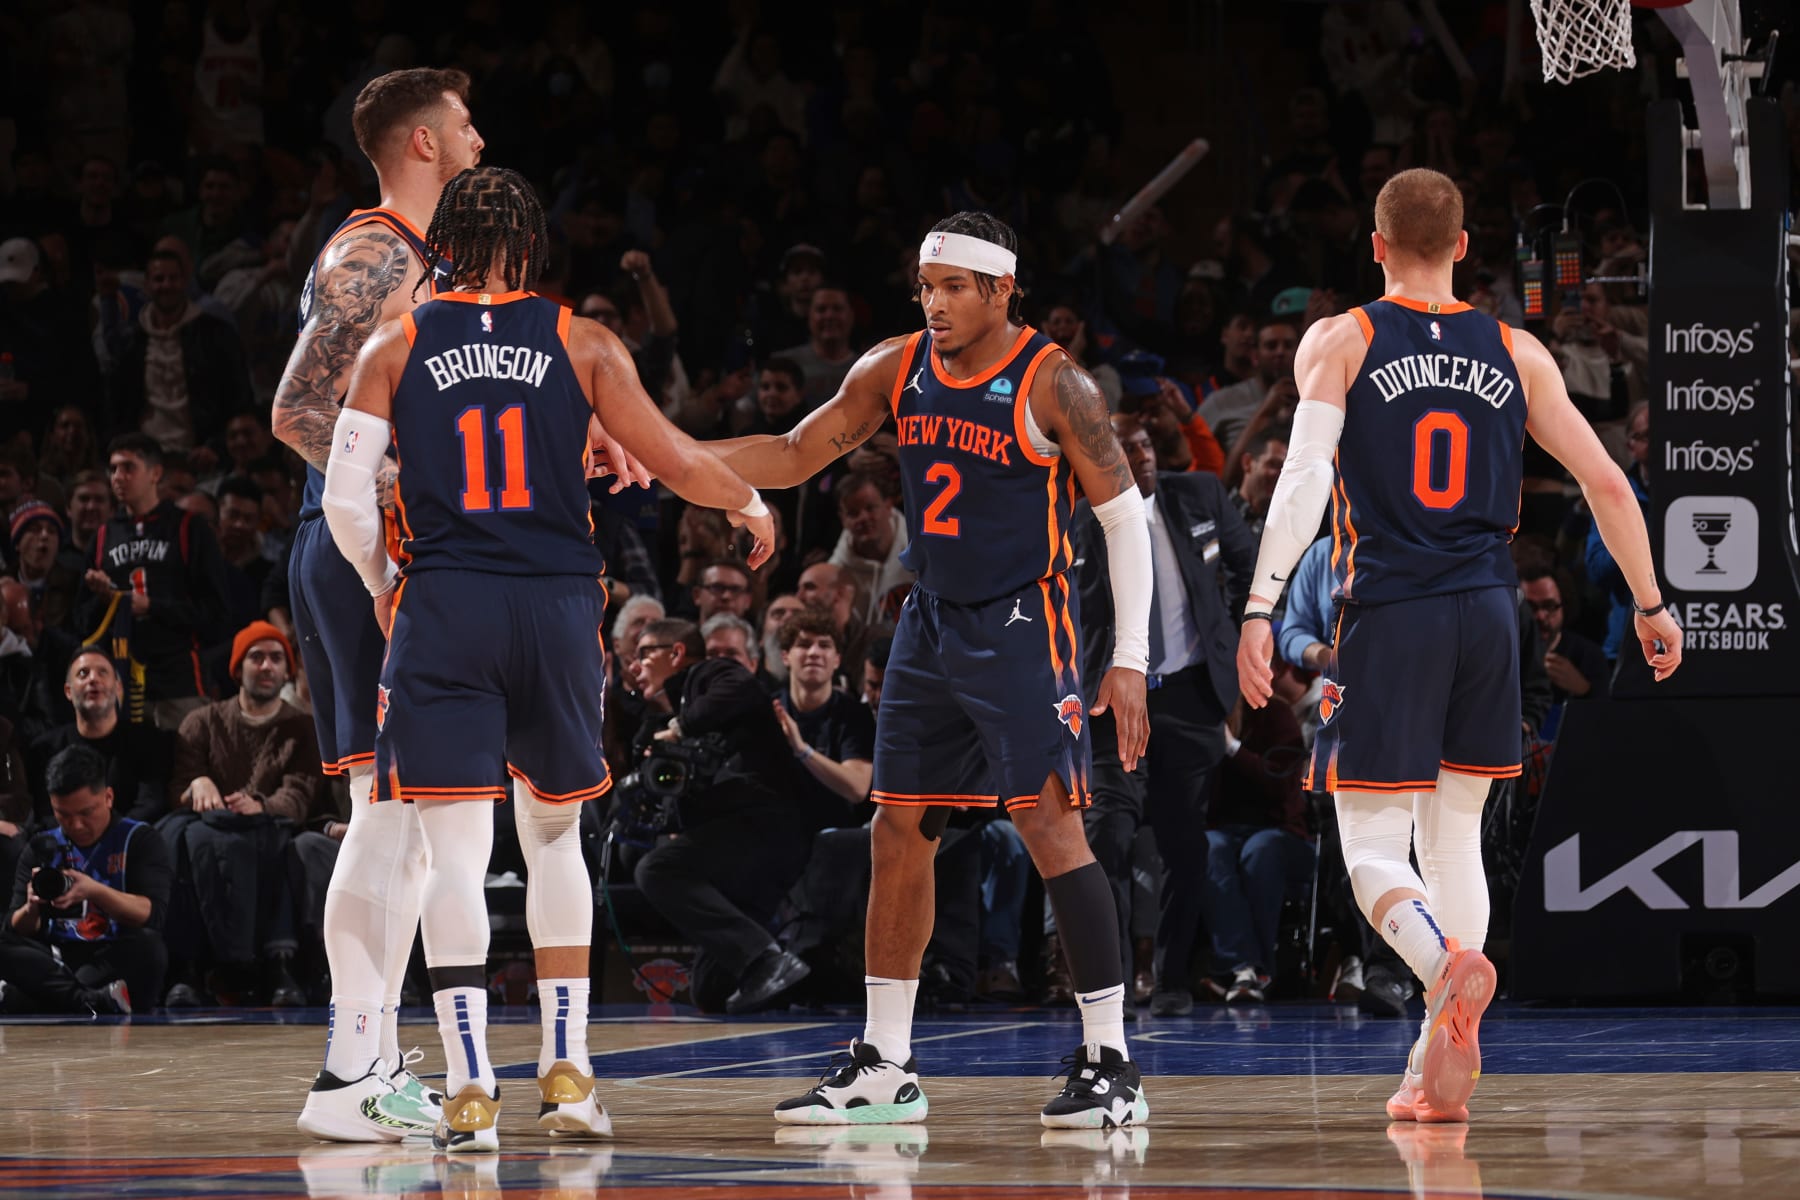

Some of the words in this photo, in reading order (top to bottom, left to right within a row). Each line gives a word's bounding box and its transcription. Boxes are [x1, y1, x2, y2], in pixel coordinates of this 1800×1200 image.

[1665, 322, 1755, 359] Infosys
[424, 343, 553, 392] BRUNSON
[1368, 354, 1514, 410] DIVINCENZO
[984, 393, 1014, 405] sphere
[1666, 380, 1755, 417] Infosys
[456, 404, 535, 512] 11
[896, 414, 944, 448] NEW
[944, 416, 1014, 468] YORK
[1411, 406, 1471, 512] 0
[1665, 439, 1755, 476] Infosys
[921, 460, 962, 539] 2
[108, 538, 171, 568] TOPPIN
[129, 566, 148, 595] 1
[1667, 602, 1785, 630] AESARS
[1682, 630, 1770, 650] RTSBOOK
